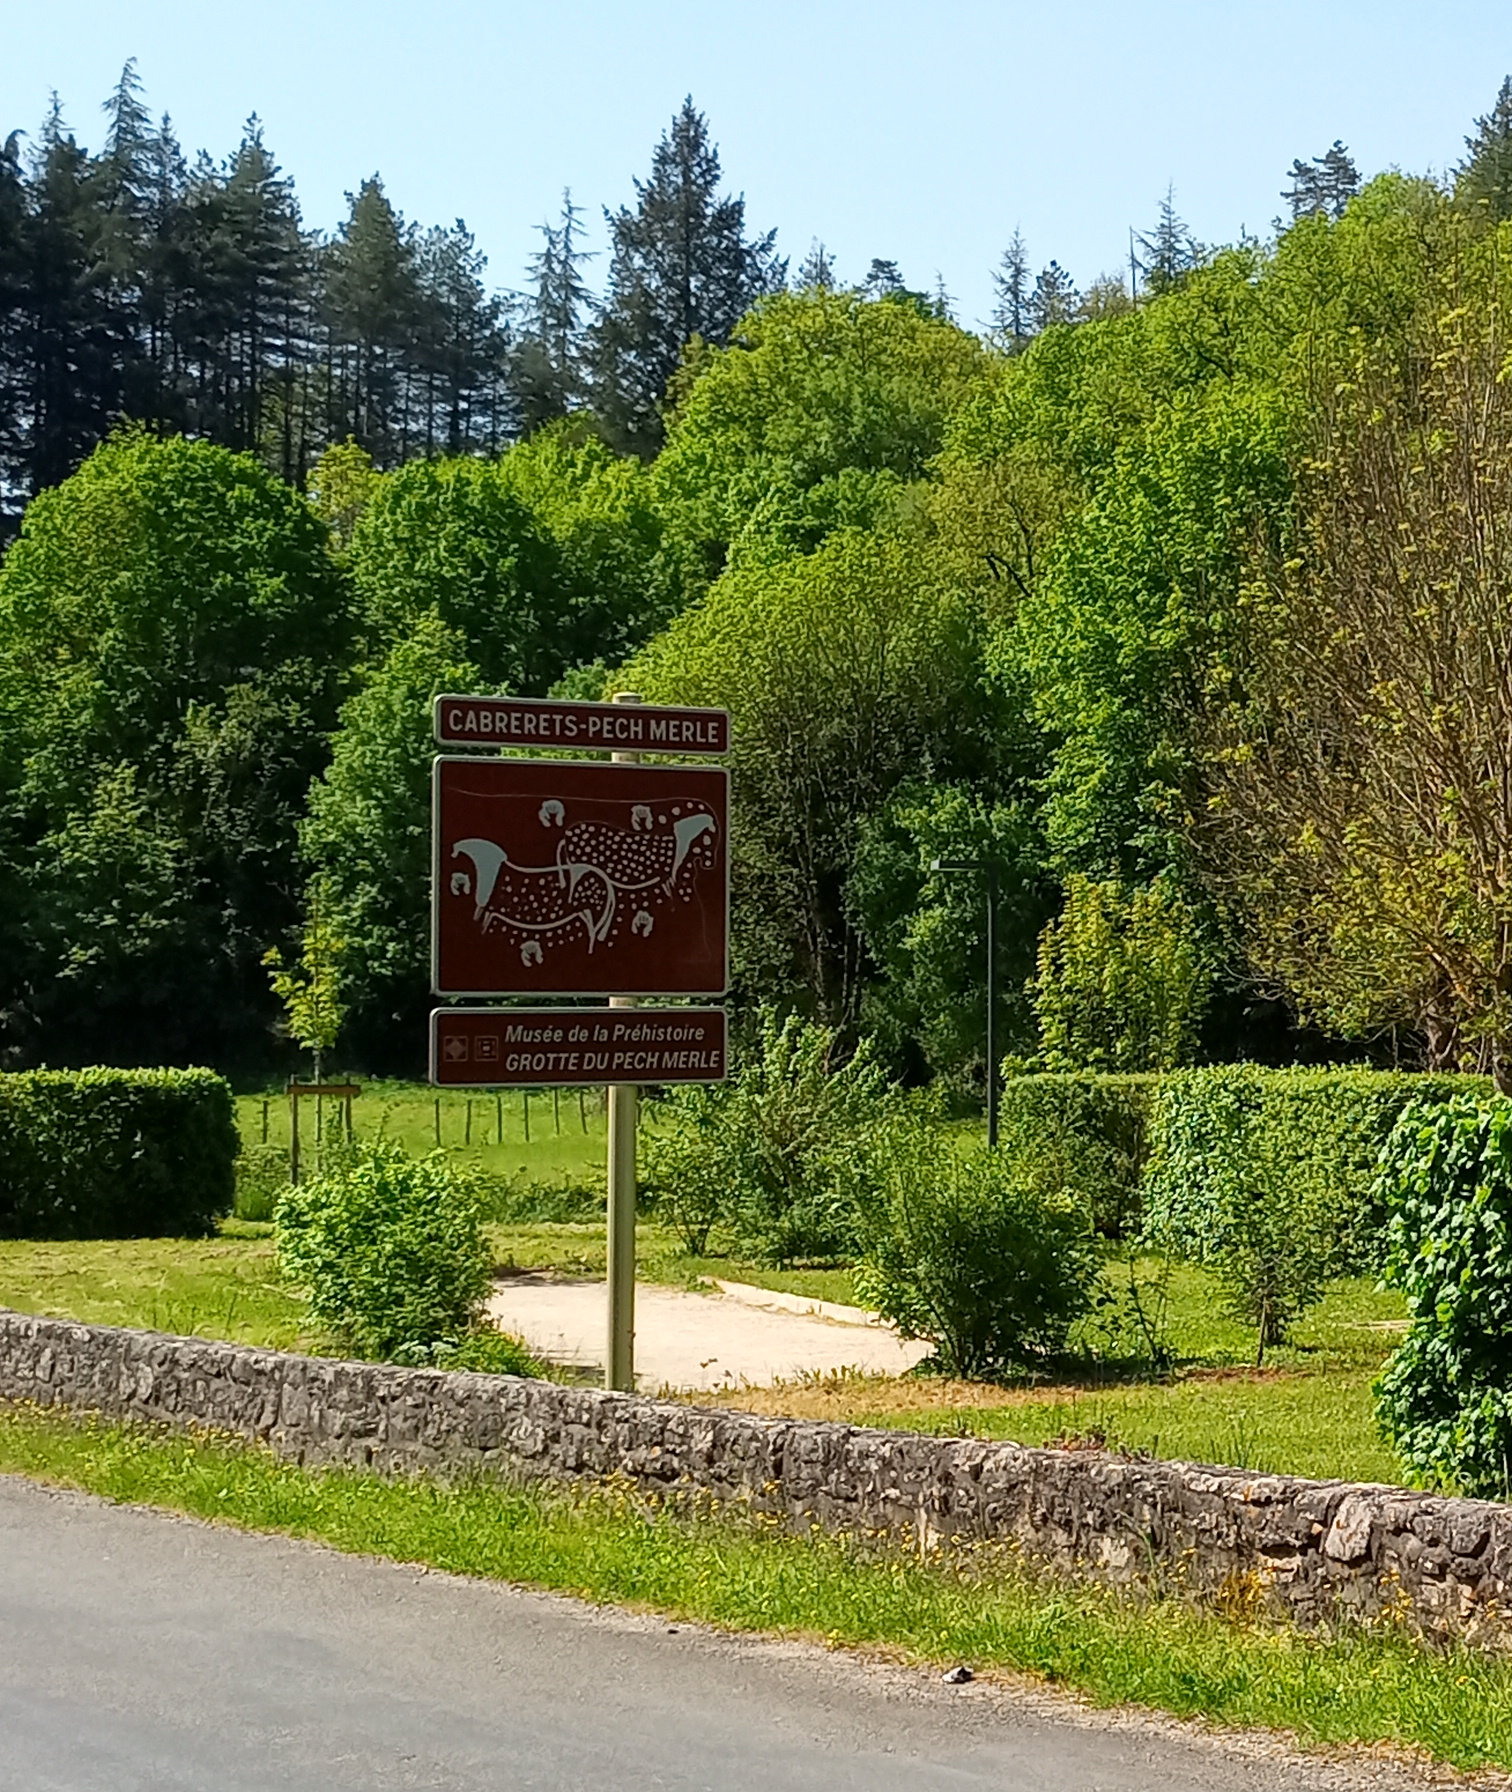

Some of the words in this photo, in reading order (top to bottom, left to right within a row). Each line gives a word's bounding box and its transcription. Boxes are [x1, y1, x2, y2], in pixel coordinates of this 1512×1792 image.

[450, 709, 643, 739] CABRERETS-PECH
[650, 719, 719, 743] MERLE
[505, 1024, 562, 1043] Musée
[568, 1024, 588, 1042] de
[593, 1024, 609, 1042] la
[612, 1023, 705, 1042] Préhistoire
[505, 1053, 578, 1071] GROTTE
[583, 1052, 609, 1071] DU
[612, 1051, 659, 1070] PECH
[662, 1050, 720, 1069] MERLE
